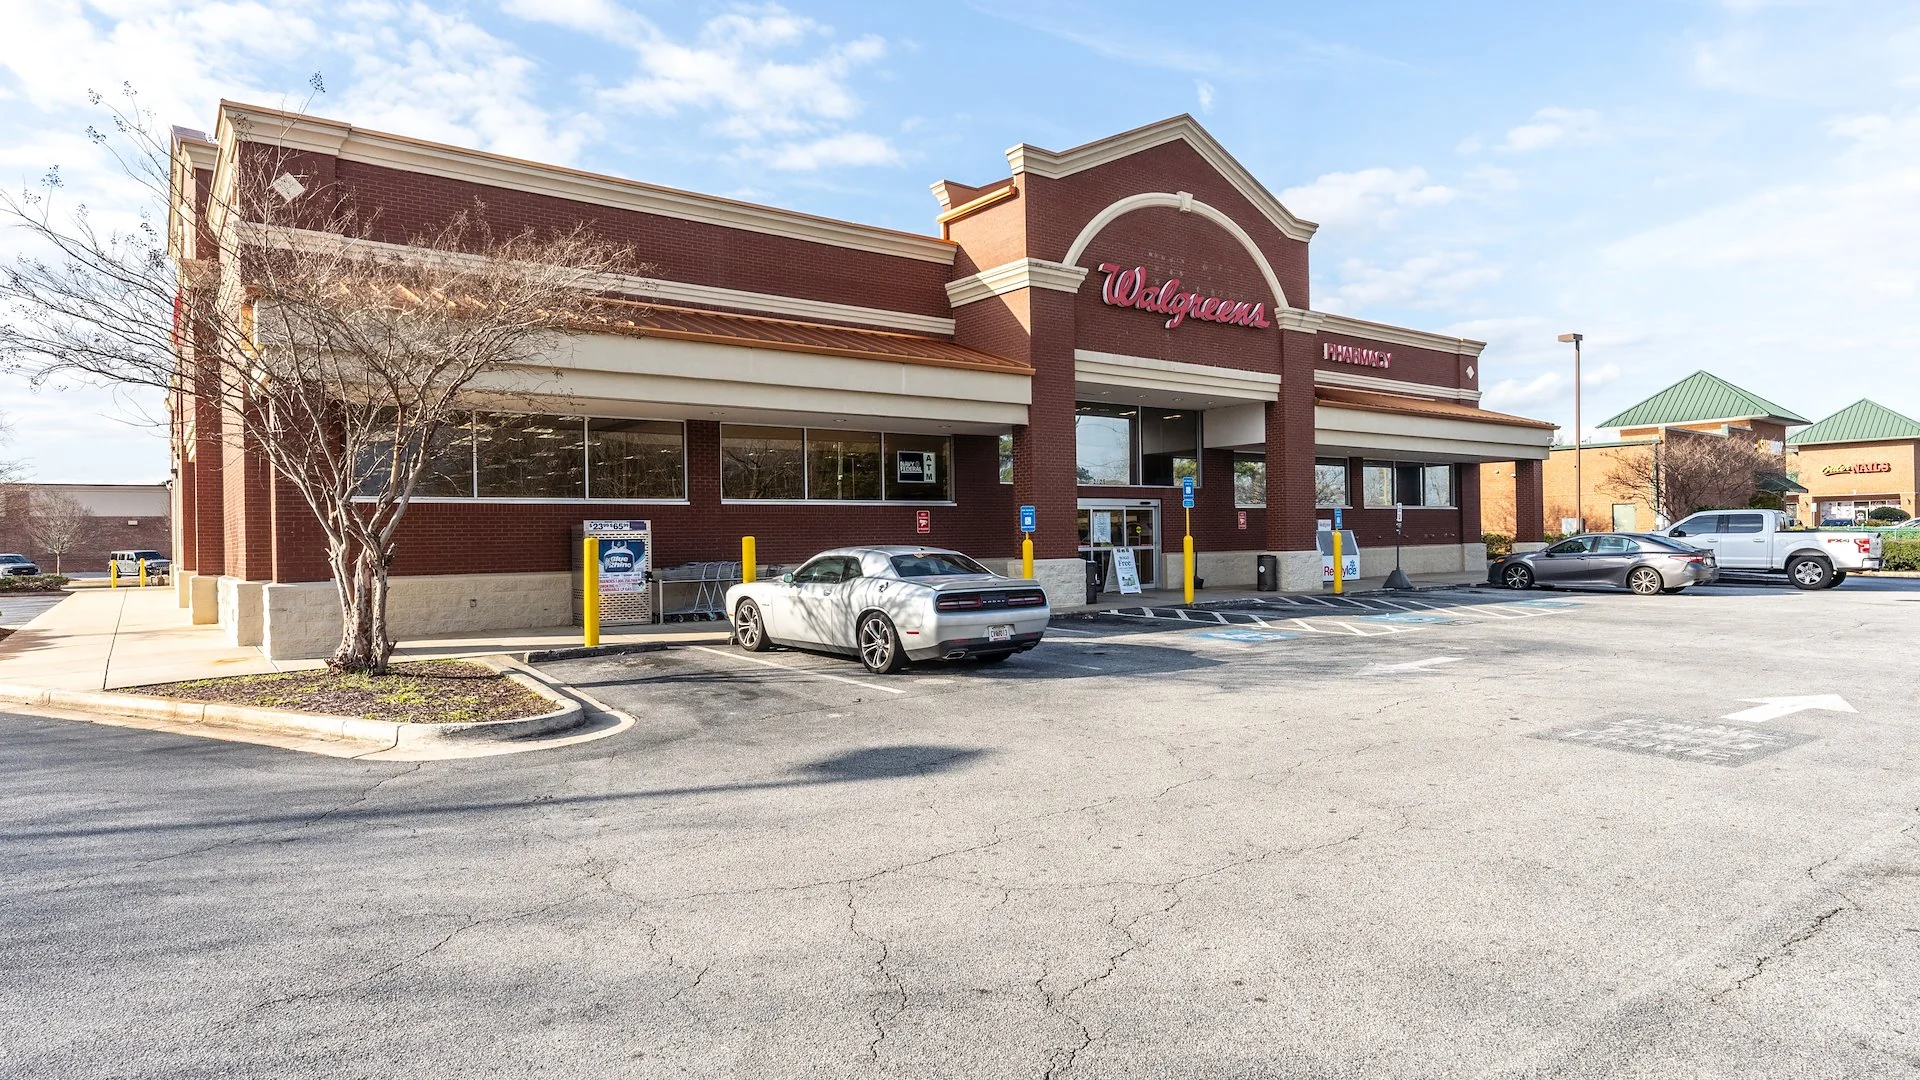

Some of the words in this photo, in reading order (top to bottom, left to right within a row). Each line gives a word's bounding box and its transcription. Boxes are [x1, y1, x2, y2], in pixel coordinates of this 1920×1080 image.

[1098, 262, 1270, 329] Walgreens
[1323, 342, 1392, 369] PHARMACY
[1851, 462, 1891, 474] NAILS
[1323, 565, 1357, 577] ReyIce
